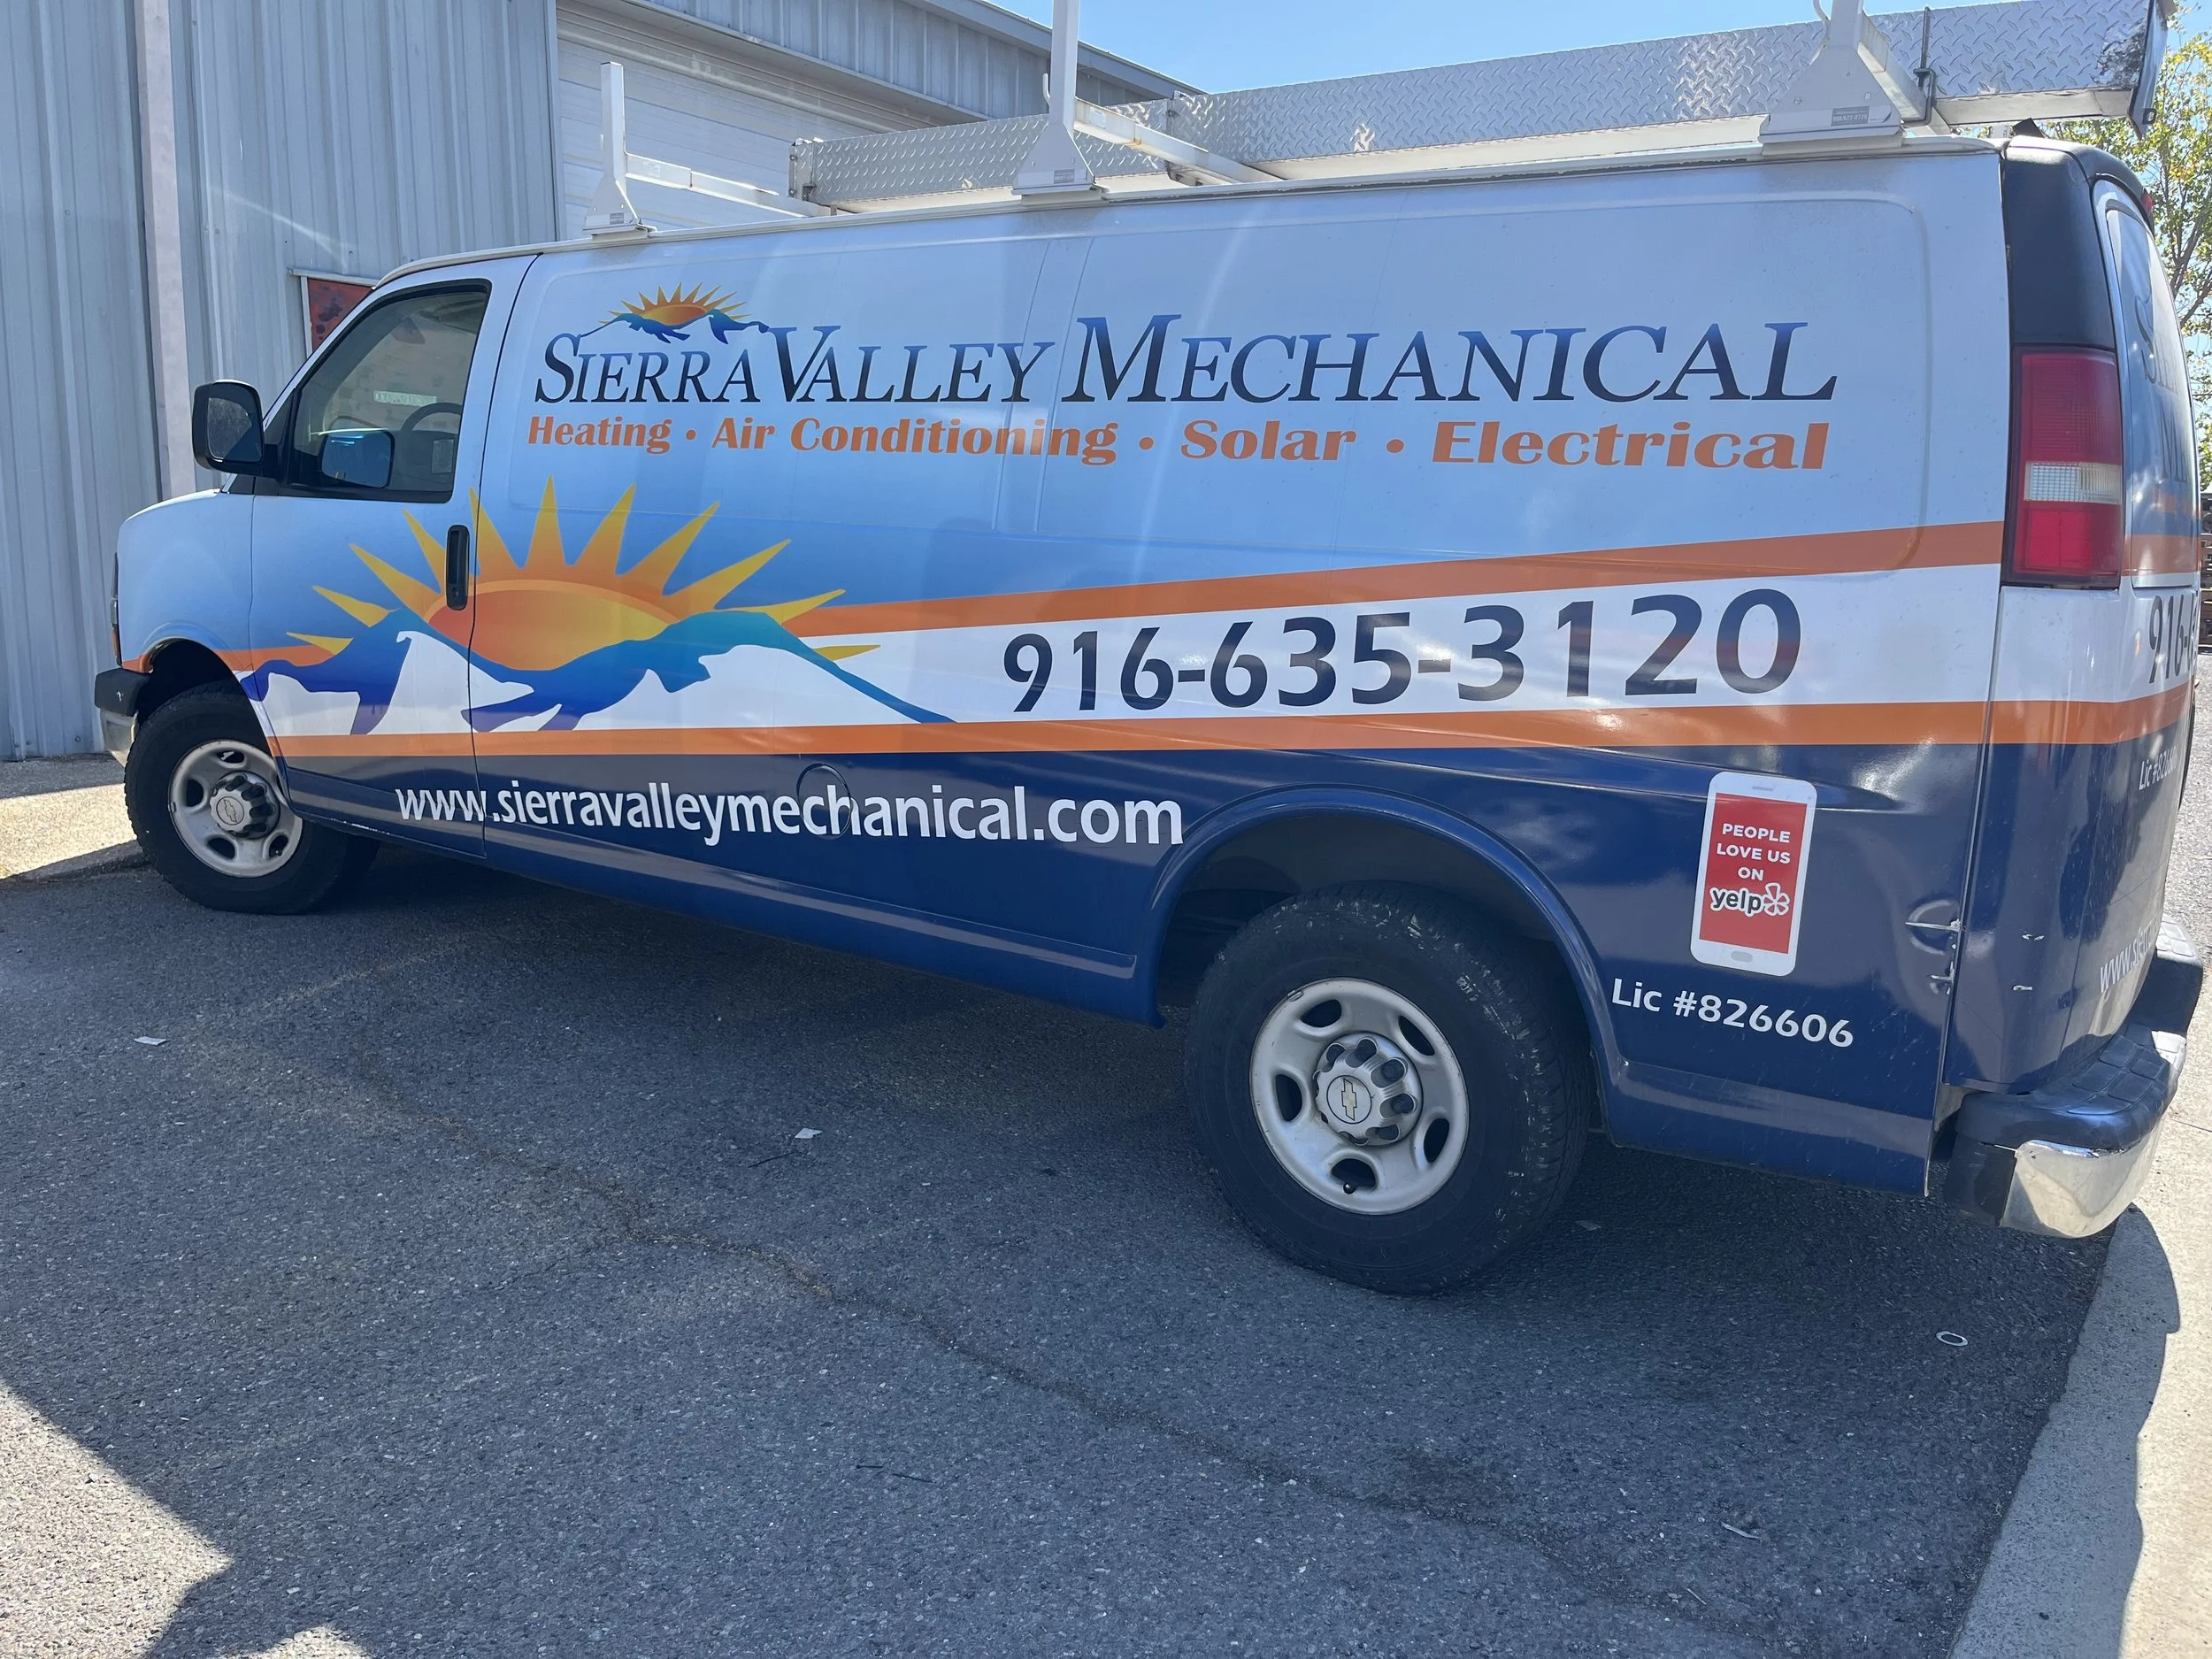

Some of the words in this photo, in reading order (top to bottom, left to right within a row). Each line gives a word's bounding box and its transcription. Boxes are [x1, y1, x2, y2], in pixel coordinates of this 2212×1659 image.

[534, 333, 761, 403] SIERRA
[769, 326, 1056, 403] VALLEY
[1062, 314, 1838, 403] MECHANICAL
[528, 416, 672, 455] Heating
[711, 417, 775, 450] Air
[791, 418, 1118, 465] Conditioning
[1179, 419, 1356, 462] Solar
[1432, 420, 1830, 471] Electrical
[1003, 588, 1801, 713] 916-635-3120
[395, 780, 1184, 846] www.sierravalleymechanical.com
[1723, 823, 1791, 843] PEOPLE
[1717, 843, 1763, 860] LOVE
[1768, 850, 1790, 864] US
[1738, 866, 1763, 880] ON
[1710, 887, 1763, 916] yelp
[1612, 978, 1663, 1011] Lic
[1673, 990, 1854, 1048] #826606
